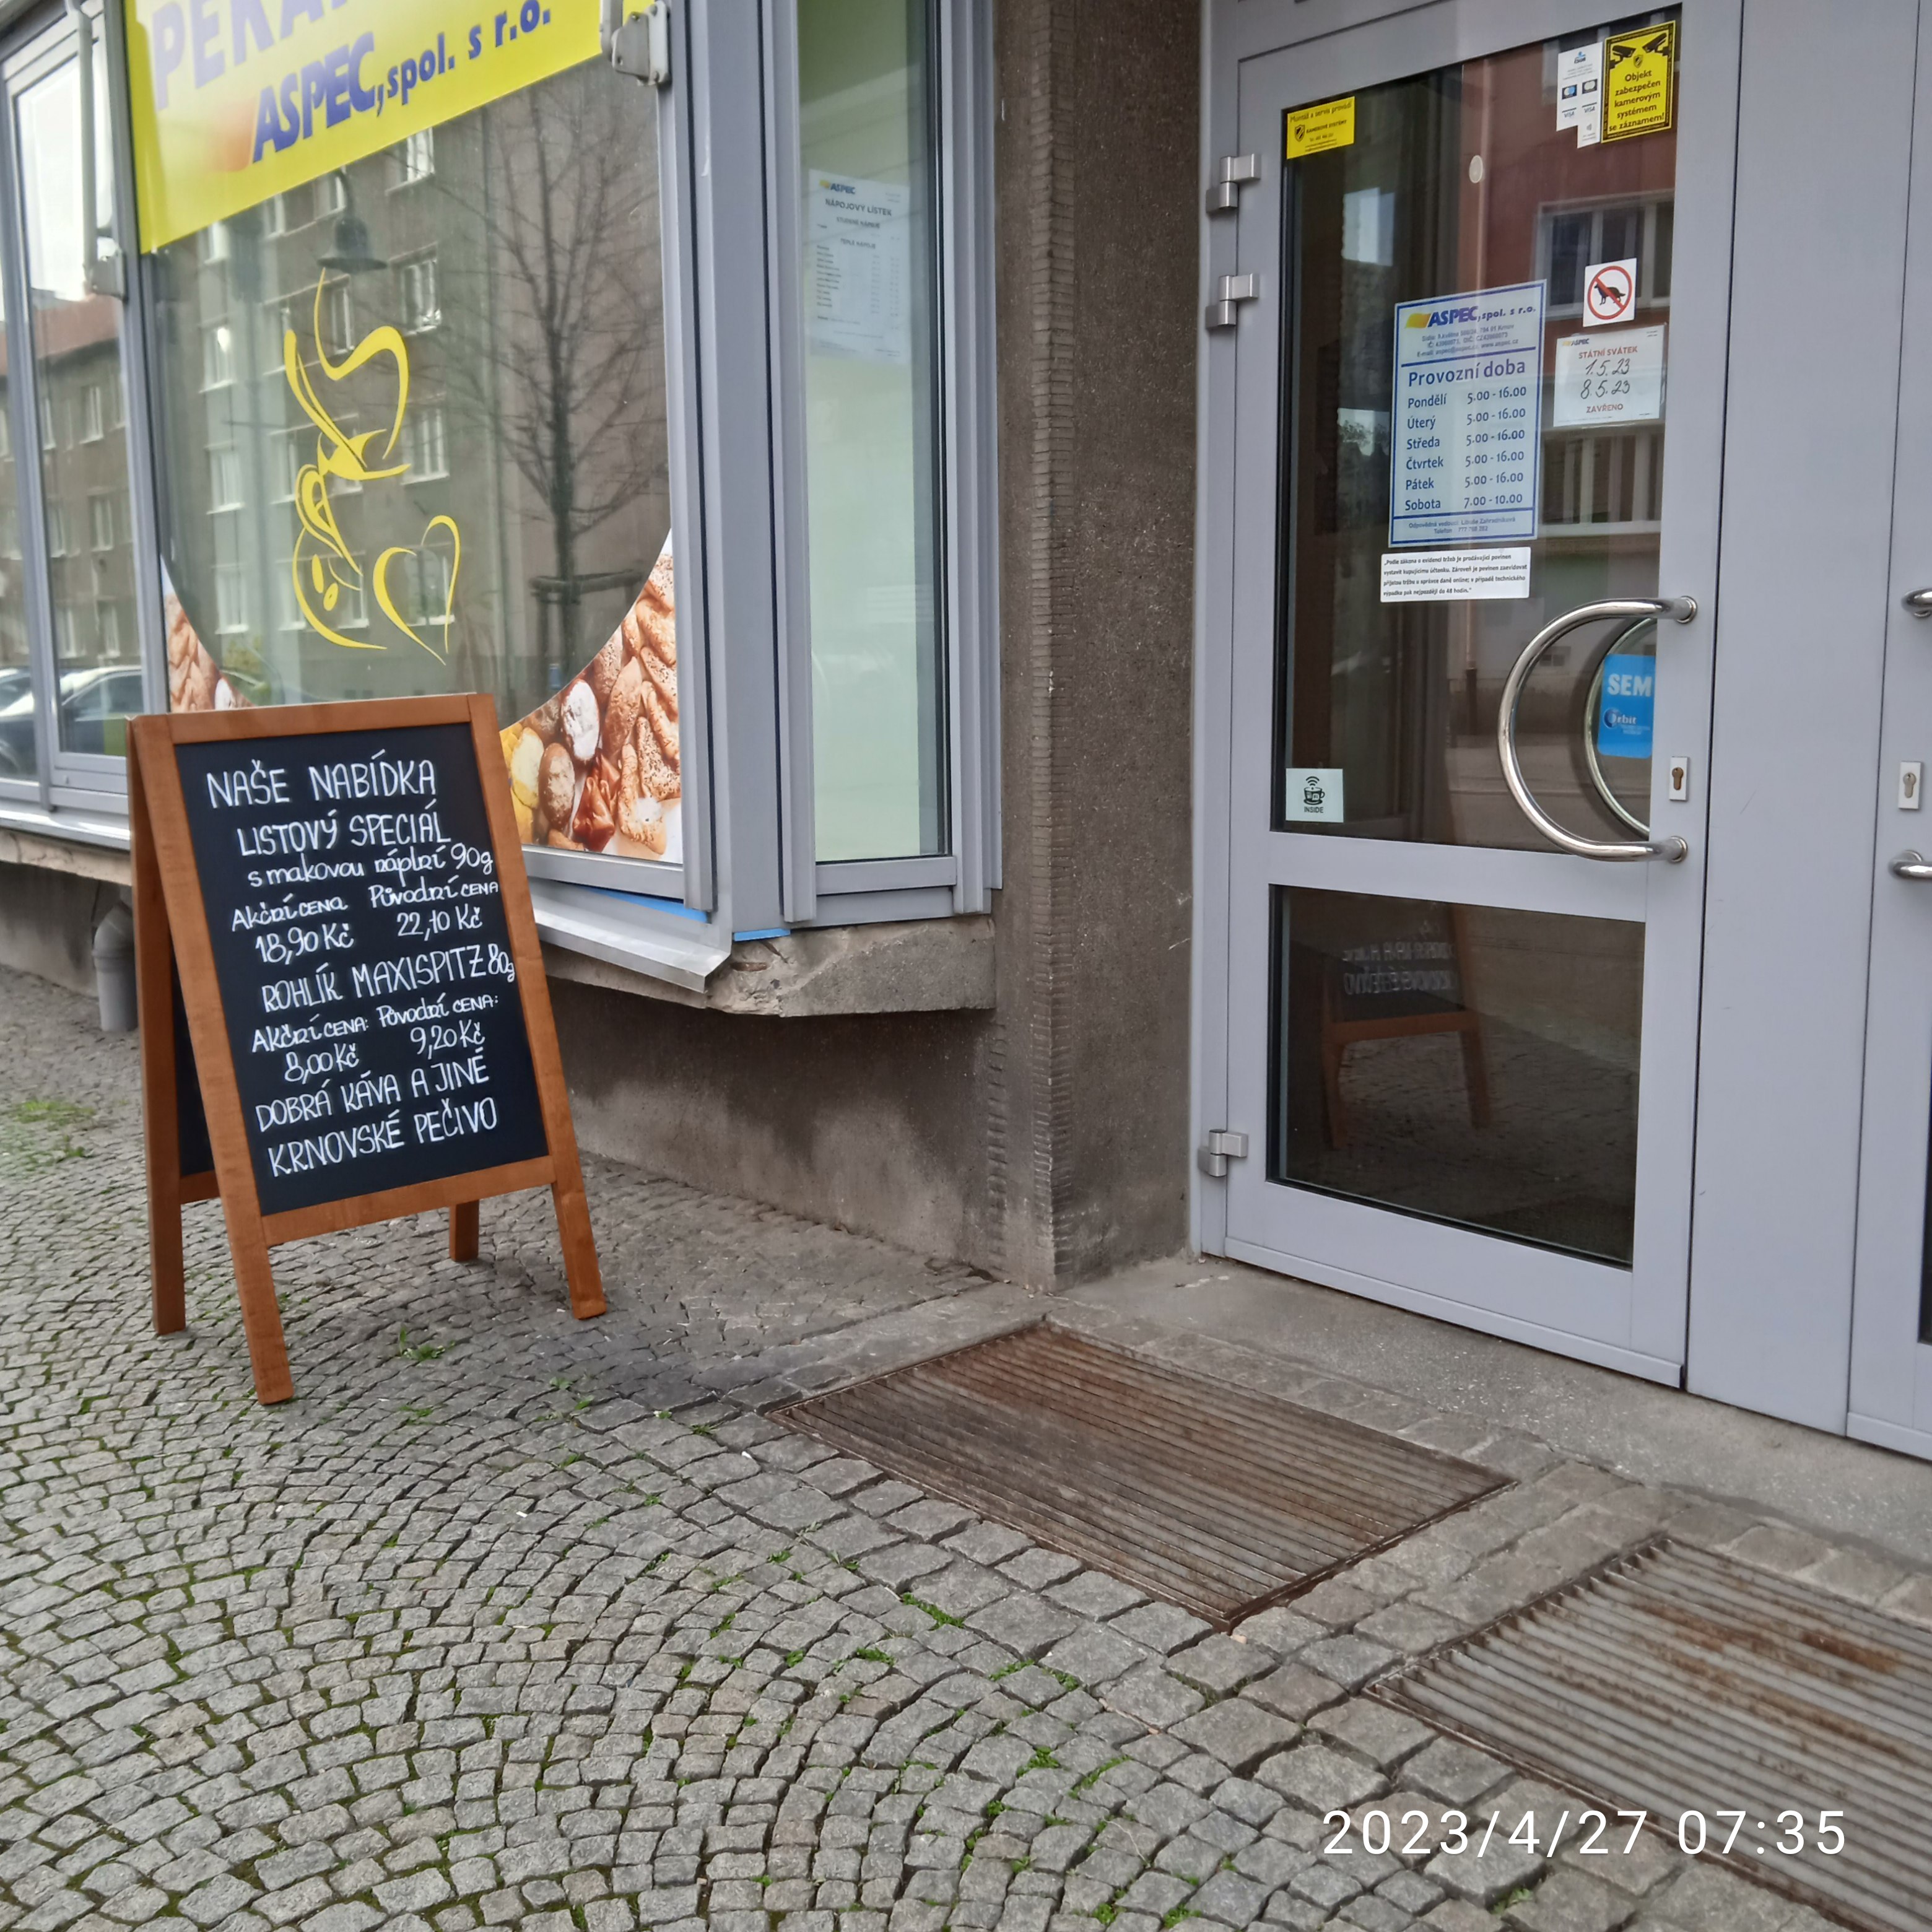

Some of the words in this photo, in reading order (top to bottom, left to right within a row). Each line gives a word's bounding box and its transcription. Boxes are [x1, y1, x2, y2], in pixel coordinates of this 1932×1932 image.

[468, 24, 482, 59] s
[494, 0, 550, 48] r.o.
[1625, 69, 1652, 82] Objekt
[1615, 80, 1661, 96] zabezpečen
[1614, 92, 1661, 108] kamerovým
[1609, 124, 1617, 132] se
[1619, 113, 1664, 130] záznamem!
[1617, 104, 1656, 120] systémem
[830, 183, 856, 194] ASPEC
[868, 205, 892, 217] LÍSTEK
[1518, 305, 1536, 315] r.o.
[1579, 347, 1605, 359] STÁTNÍ
[1607, 346, 1638, 357] SVÁTEK
[1409, 362, 1481, 386] Provozní
[1484, 359, 1525, 378] doba
[1408, 393, 1447, 409] Pondělí
[1467, 391, 1489, 404] 5.00
[1499, 386, 1526, 398] 16.00
[1586, 403, 1624, 413] ZAVŘENO
[1407, 416, 1436, 430] Úterý
[1466, 412, 1489, 425] 5.00
[1498, 408, 1526, 419] 16.00
[1406, 436, 1440, 450] Středa
[1466, 433, 1488, 446] 5.00
[1497, 429, 1525, 441] 16.00
[1406, 456, 1443, 470] Čtvrtek
[1465, 455, 1487, 468] 5.00
[1497, 451, 1524, 463] 16.00
[1406, 477, 1434, 490] Pátek
[1464, 475, 1487, 488] 5.00
[1496, 472, 1523, 484] 16.00
[1405, 498, 1441, 511] Sobota
[1464, 496, 1486, 509] 7.00
[1495, 494, 1523, 505] 10.00
[1608, 673, 1652, 697] SEM
[206, 759, 290, 809] NAŠE
[309, 749, 436, 800] NABÍDKA
[237, 809, 337, 857] LISTOVÝ
[350, 799, 451, 846] SPECIÁL
[269, 853, 364, 885] makovou
[375, 845, 446, 886] náplní
[450, 842, 494, 875] 90g
[255, 926, 319, 965] 18,90
[322, 923, 354, 949] Kč
[397, 909, 450, 941] 22,10
[455, 903, 482, 931] Kč
[262, 962, 342, 1012] ROHLÍK
[352, 944, 486, 998] MAXISPITZ
[488, 943, 515, 983] 80g
[410, 1025, 457, 1060] 9,20
[459, 1019, 485, 1048] Kč
[256, 1079, 332, 1132] DOBRÁ
[342, 1070, 401, 1113] KÁVA
[412, 1068, 429, 1098] A
[432, 1047, 489, 1092] JINÉ
[268, 1109, 404, 1177] KRNOVSKÉ
[415, 1097, 497, 1143] PEČIVO
